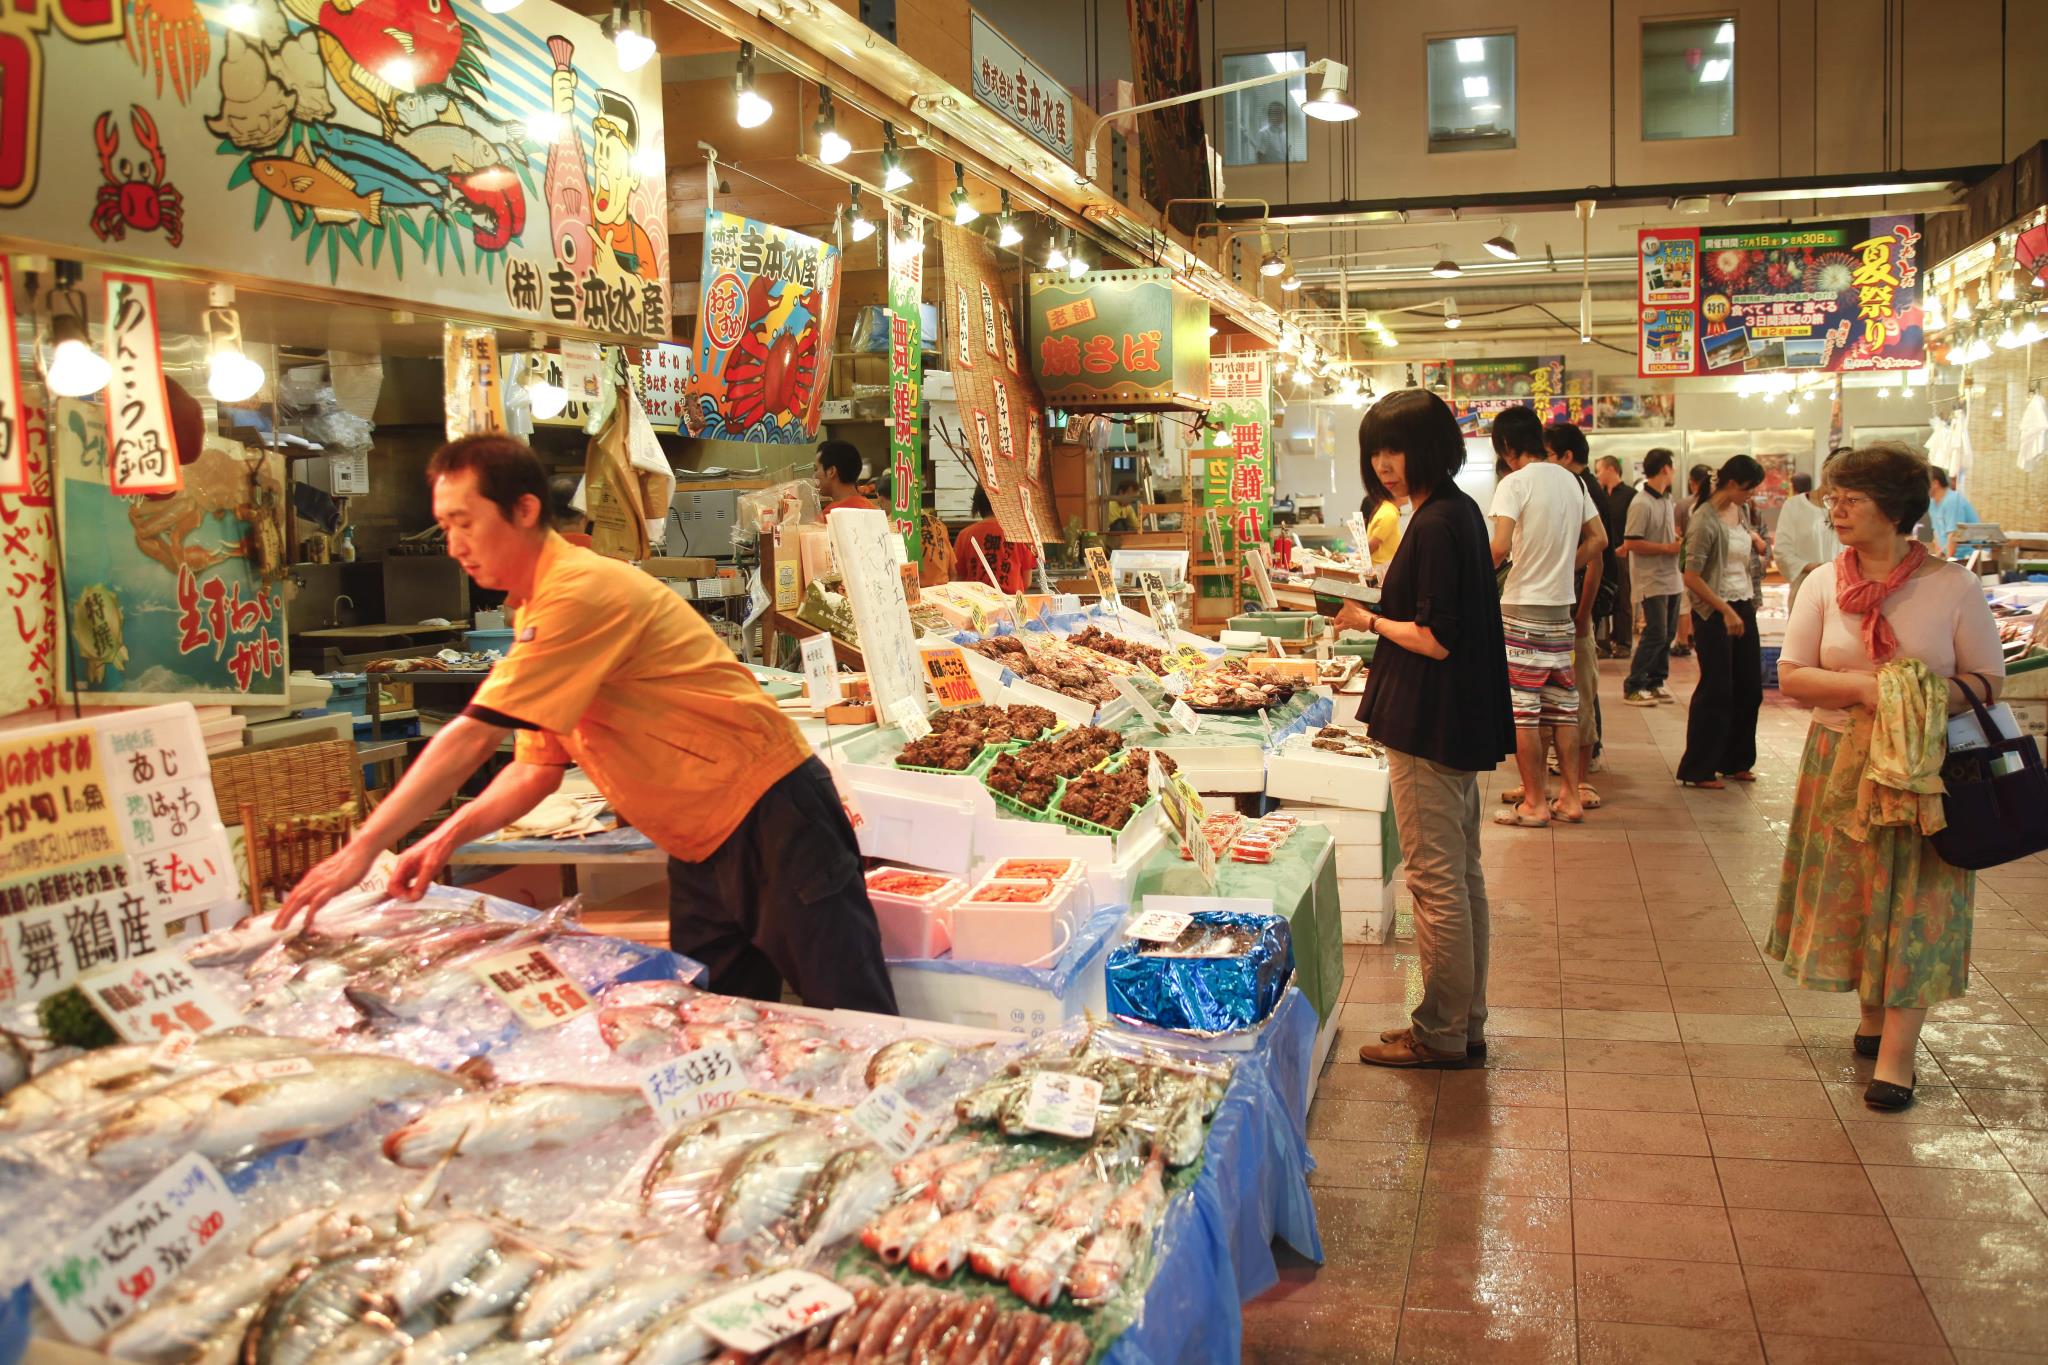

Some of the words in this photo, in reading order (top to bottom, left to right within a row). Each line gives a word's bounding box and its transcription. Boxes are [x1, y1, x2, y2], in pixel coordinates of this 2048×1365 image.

[982, 56, 1065, 144] 株式会社吉本水産
[505, 258, 665, 336] (株)吉本水産
[1051, 301, 1091, 327] 老舗
[1852, 235, 1900, 350] 夏祭り
[112, 283, 166, 484] あんこう鍋
[1041, 330, 1161, 377] 焼さば
[0, 734, 92, 793] のおすすめ
[129, 750, 178, 784] あじ
[163, 853, 216, 894] たい
[18, 891, 156, 989] 舞鶴産
